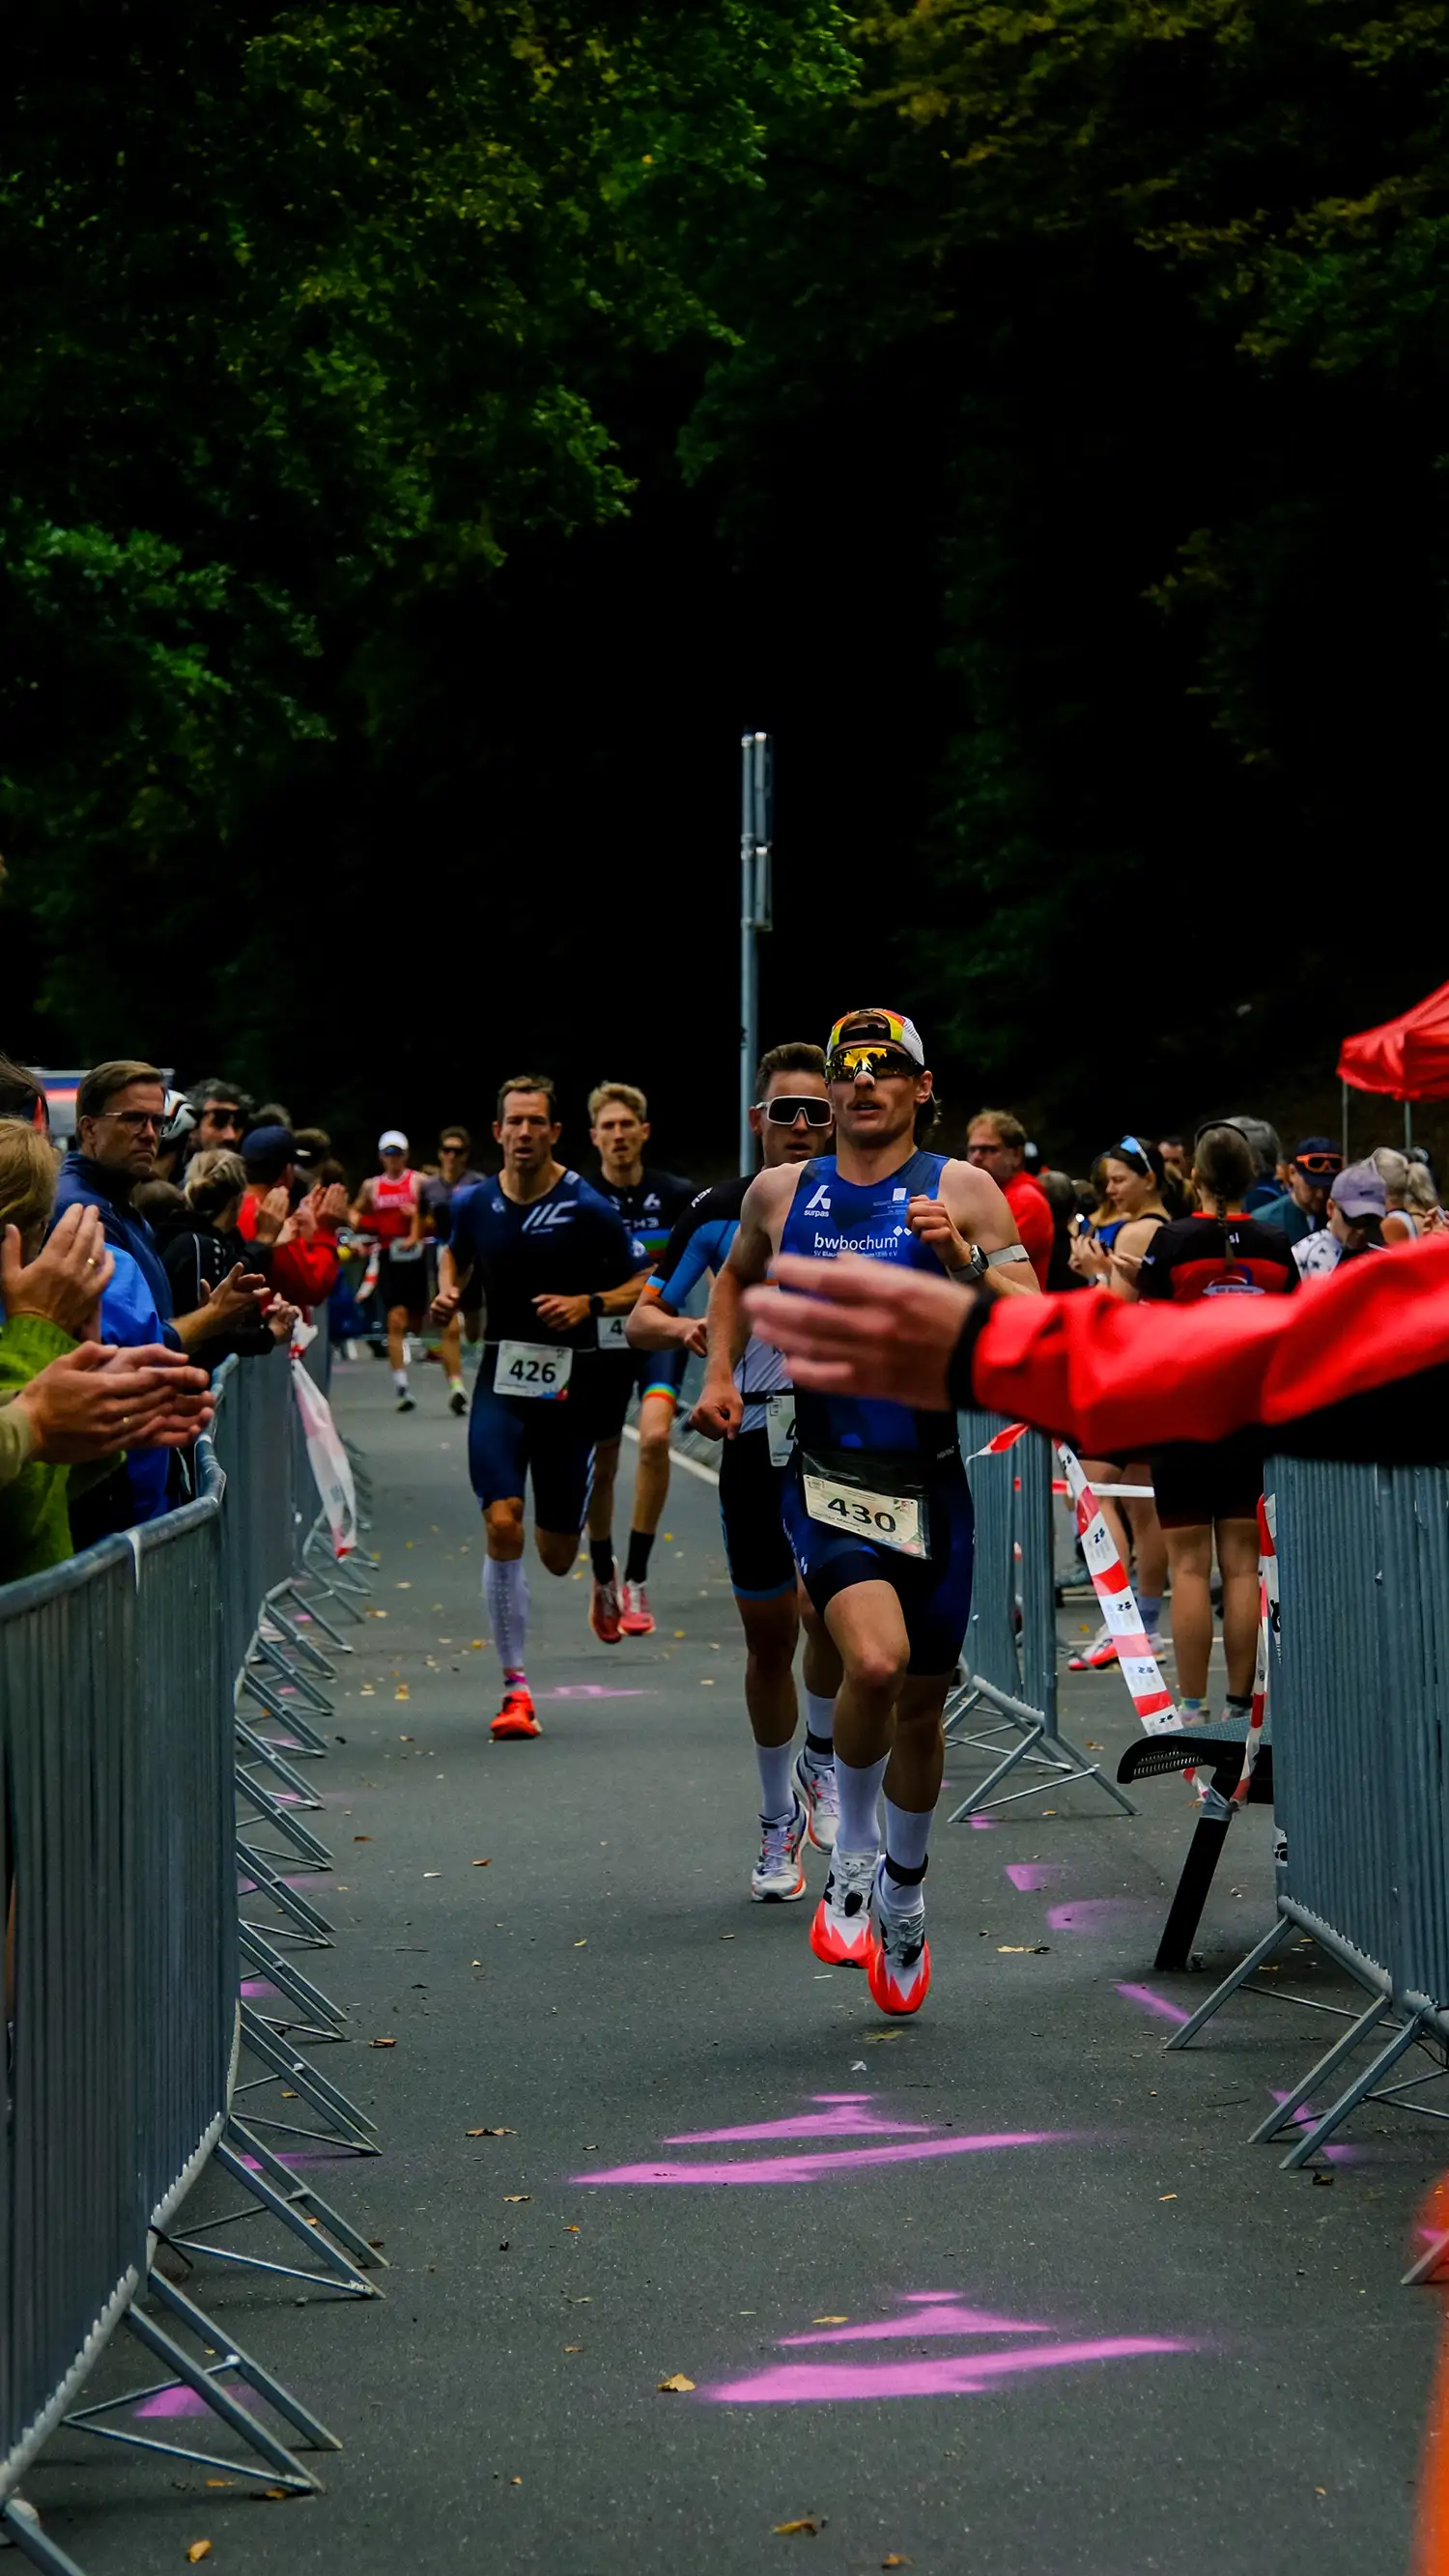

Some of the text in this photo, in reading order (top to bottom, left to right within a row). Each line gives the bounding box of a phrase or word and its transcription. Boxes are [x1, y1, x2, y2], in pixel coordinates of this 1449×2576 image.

[814, 1231, 898, 1250] bwbochum
[509, 1359, 556, 1384] 426
[827, 1497, 896, 1533] 430
